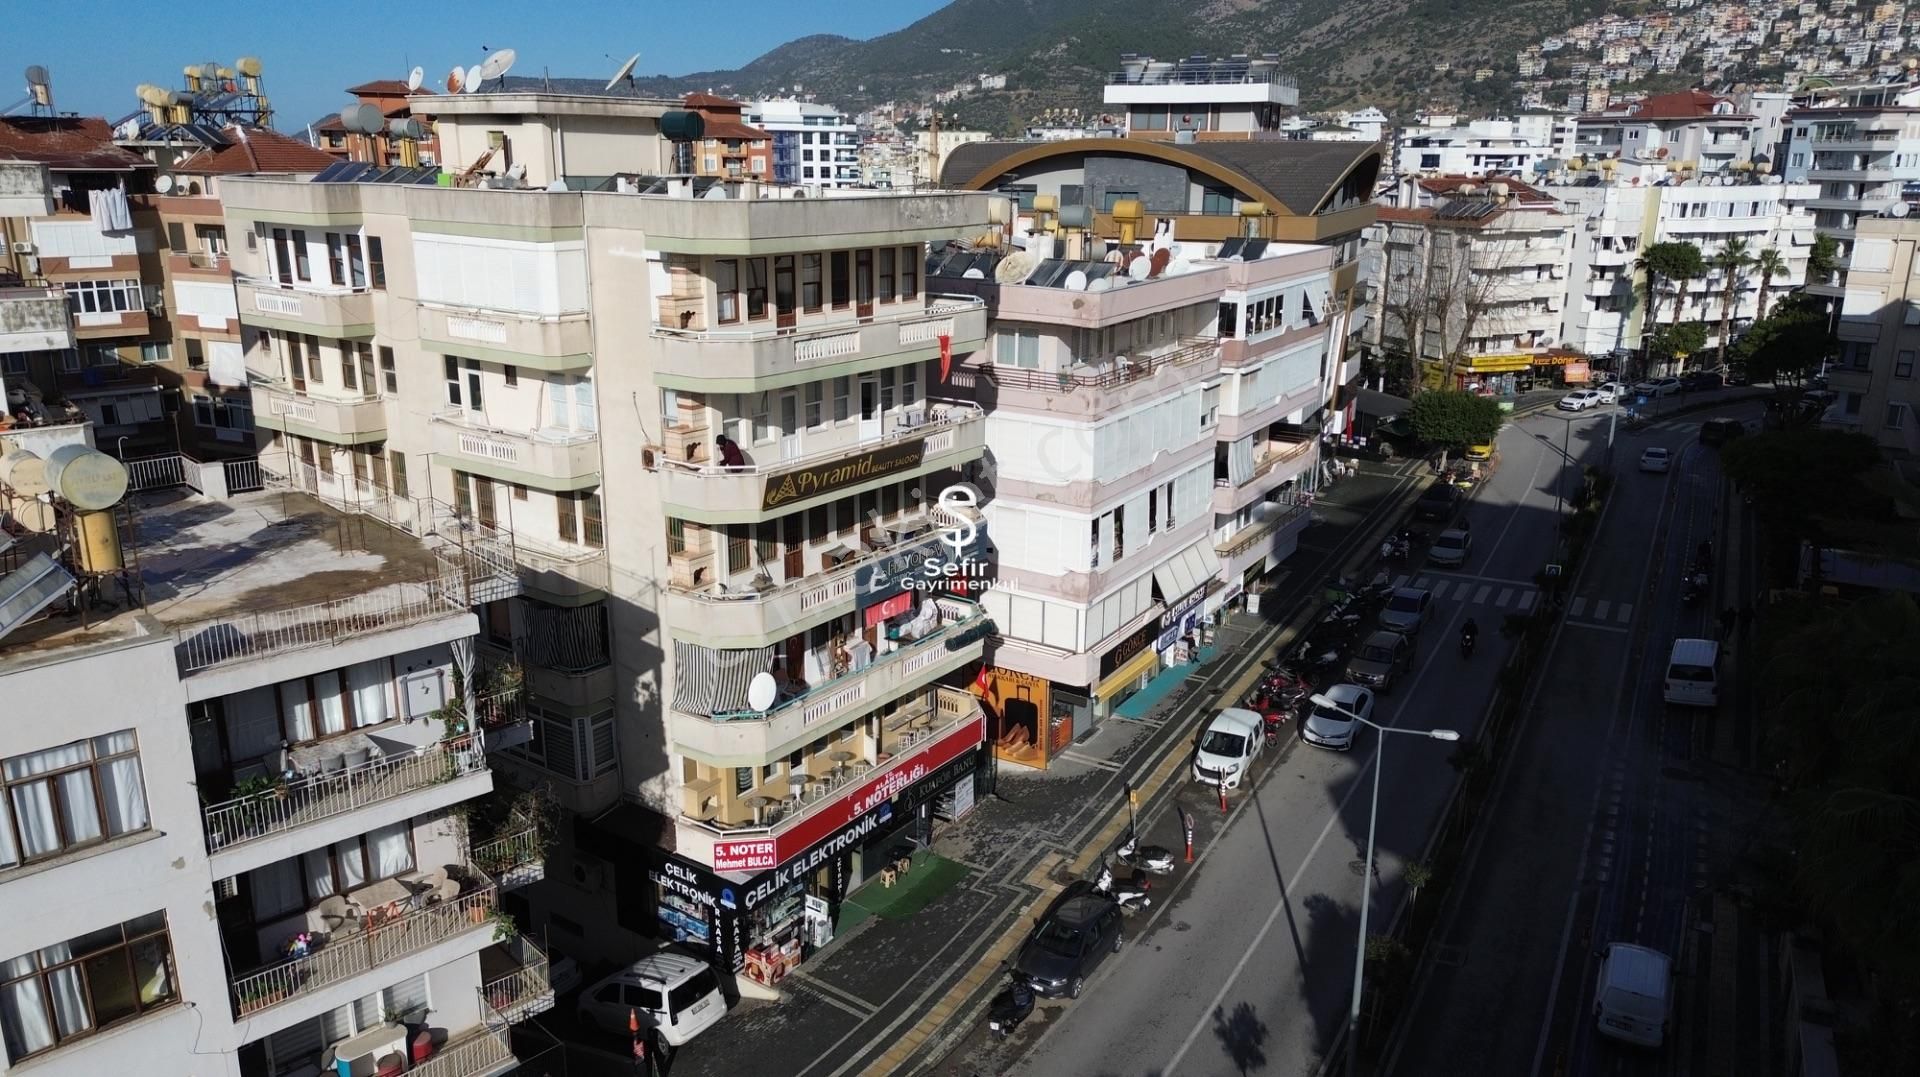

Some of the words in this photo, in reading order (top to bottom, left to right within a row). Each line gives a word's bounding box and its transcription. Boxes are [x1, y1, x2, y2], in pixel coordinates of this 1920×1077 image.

[798, 455, 873, 495] Pyramid
[872, 461, 894, 473] BEAUTY
[895, 453, 920, 467] SALOON
[853, 801, 863, 815] 5.
[865, 763, 924, 809] NOTERLİĞİ
[715, 846, 727, 856] 5.
[729, 843, 773, 856] NOTER
[715, 857, 746, 869] Mehmet
[747, 856, 774, 867] BULCA
[745, 868, 790, 910] ÇELİK
[793, 814, 878, 879] ELEKTRONİK
[649, 868, 716, 907] ELEKTRONİK
[665, 862, 697, 884] ÇELİK
[733, 917, 741, 954] KASA
